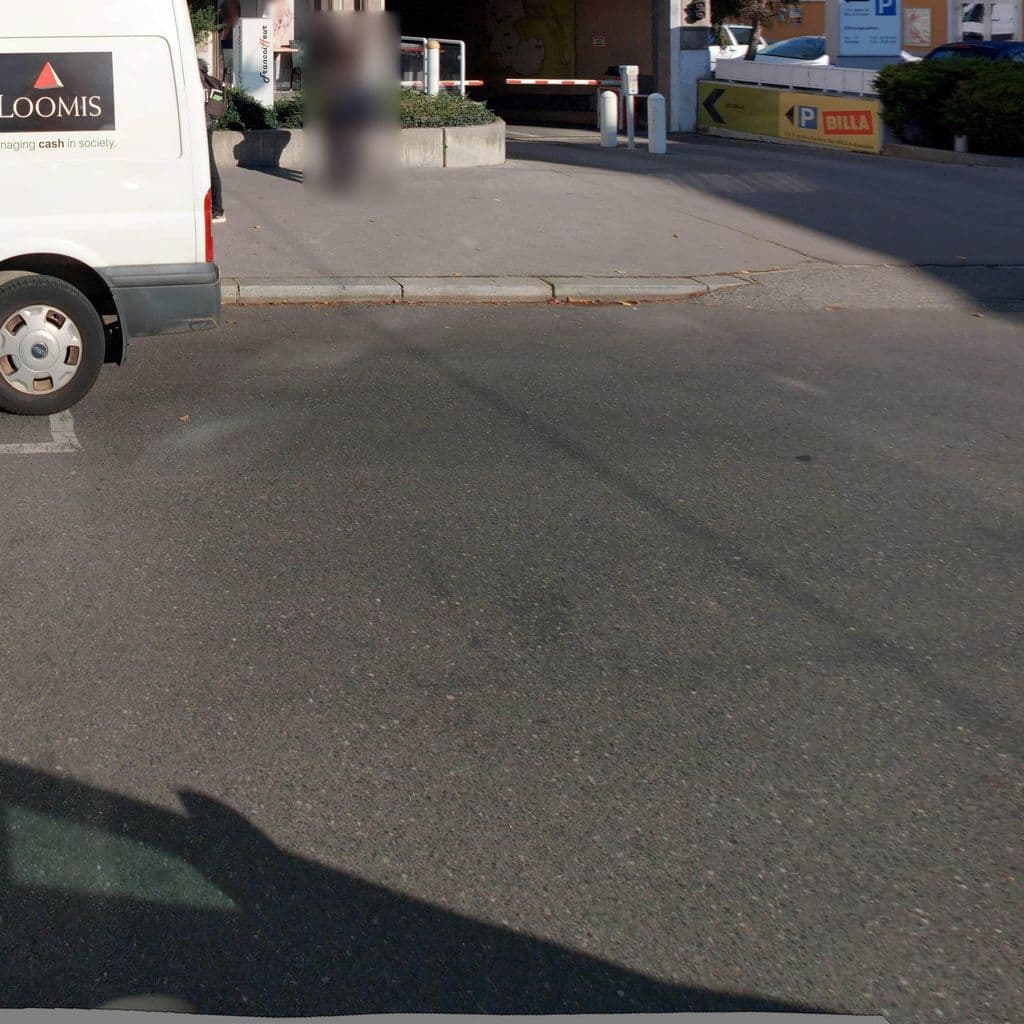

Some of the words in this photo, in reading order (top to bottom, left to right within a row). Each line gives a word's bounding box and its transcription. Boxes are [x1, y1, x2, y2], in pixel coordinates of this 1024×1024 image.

[259, 25, 270, 83] Francoiffeur
[800, 107, 815, 127] P
[827, 114, 870, 131] BILLA
[38, 139, 65, 149] cash
[67, 139, 76, 148] in
[78, 138, 117, 150] society.
